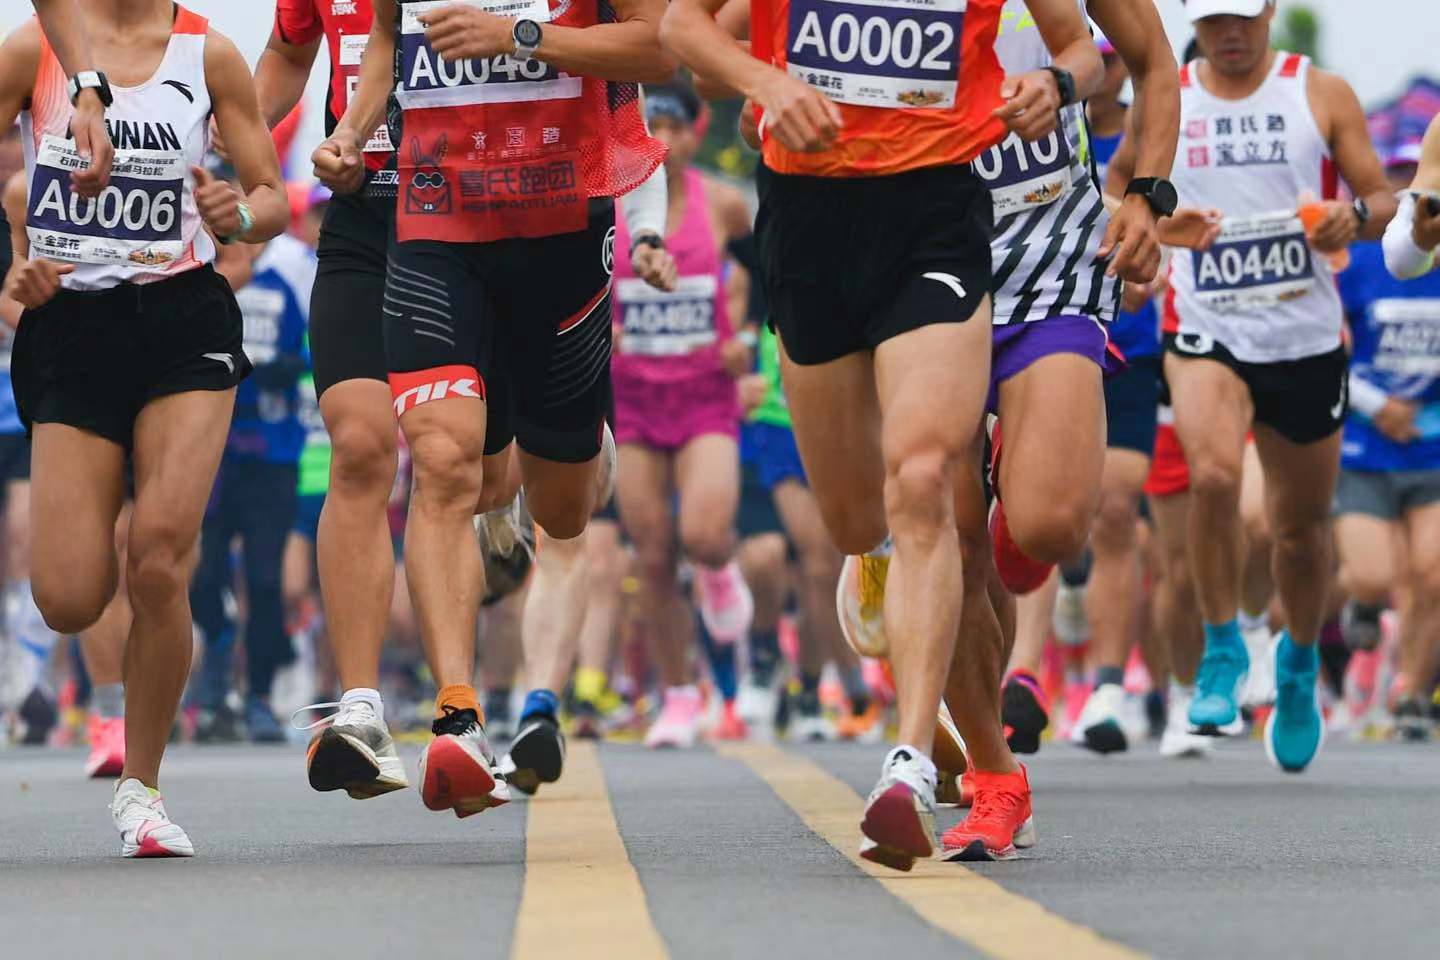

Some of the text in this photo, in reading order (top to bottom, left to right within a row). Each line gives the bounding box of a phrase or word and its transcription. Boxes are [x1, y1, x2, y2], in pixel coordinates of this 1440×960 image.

[792, 11, 955, 71] A0002
[33, 178, 176, 233] A0006
[1198, 240, 1306, 286] A0440
